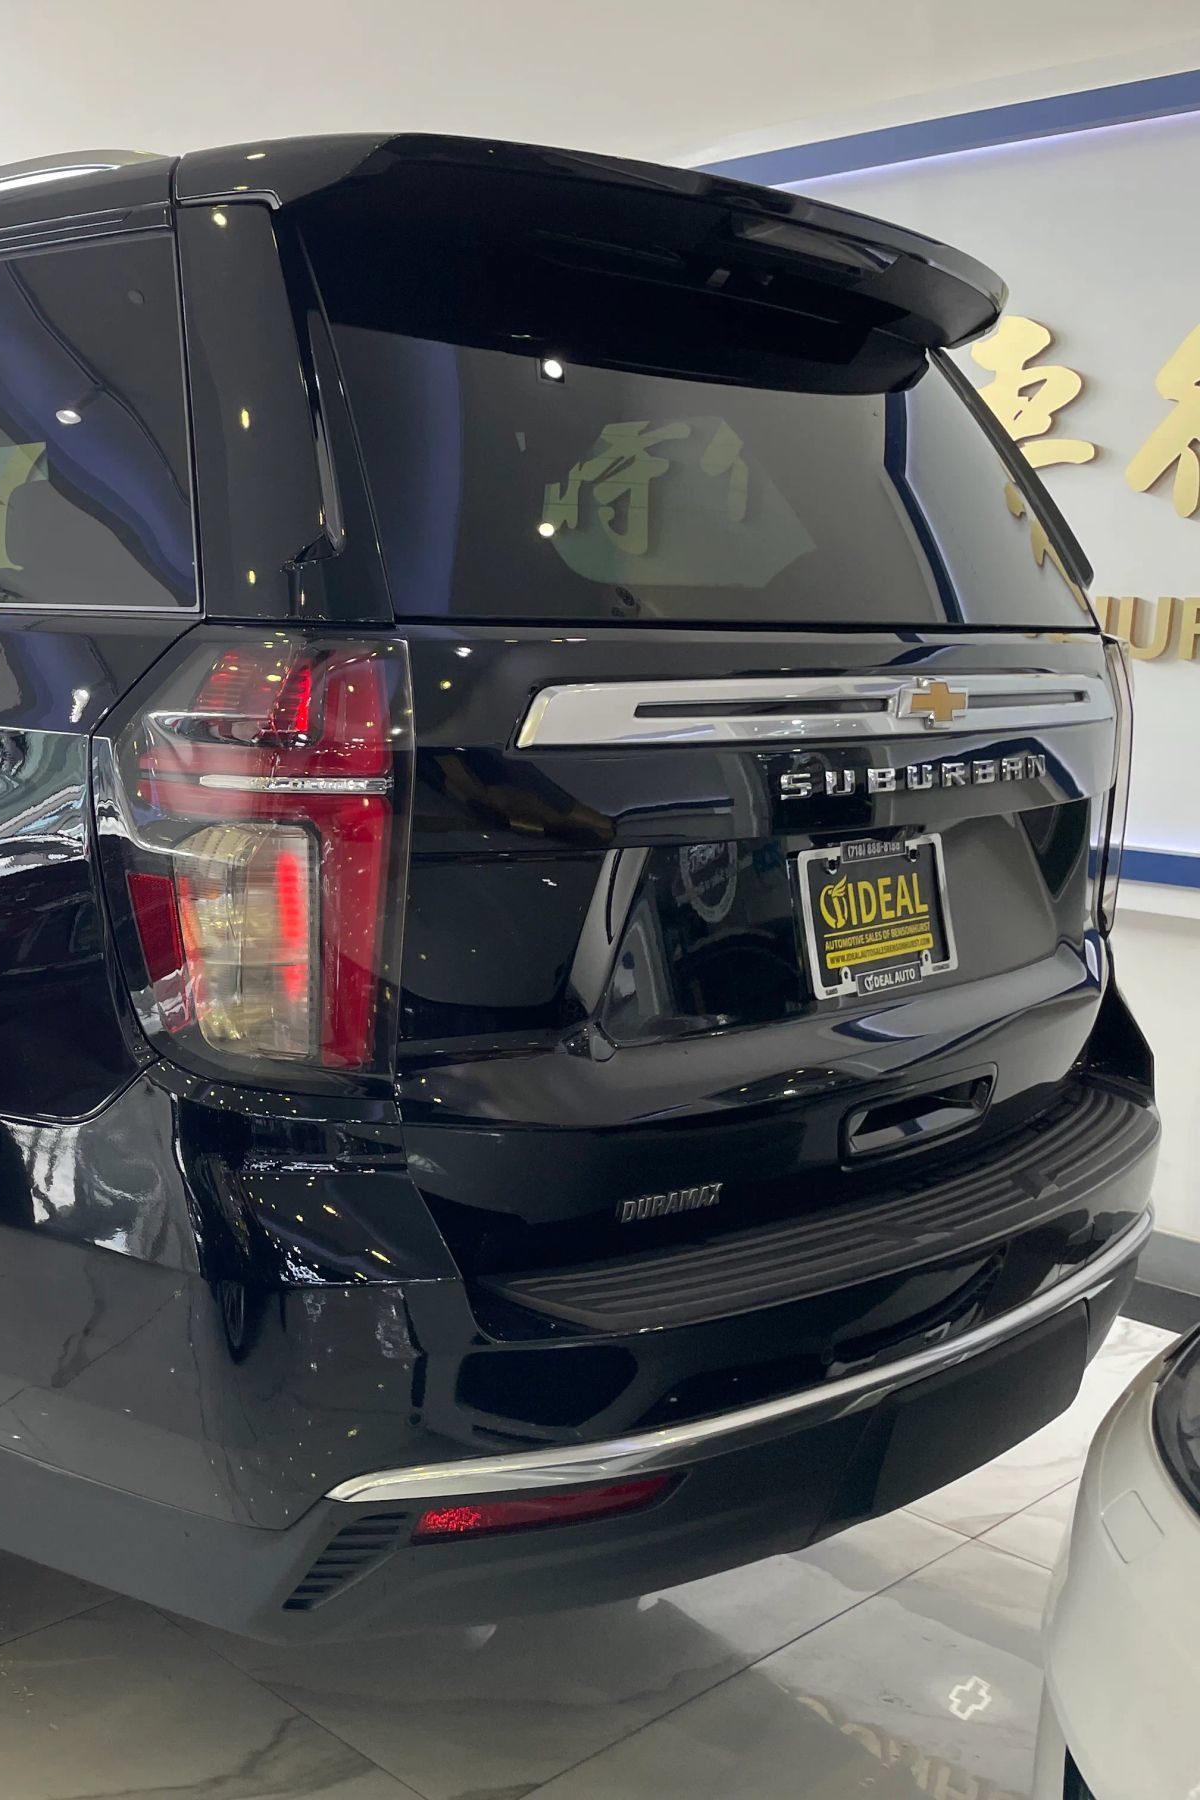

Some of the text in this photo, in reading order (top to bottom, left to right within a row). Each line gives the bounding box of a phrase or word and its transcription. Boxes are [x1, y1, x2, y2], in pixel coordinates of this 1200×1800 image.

[780, 754, 1047, 800] SUBURBAN
[847, 873, 928, 926] IDEAL
[825, 934, 865, 951] AUTOMOTIVE
[866, 931, 882, 943] SALES
[882, 929, 890, 940] OF
[895, 968, 915, 983] AUTO
[620, 1182, 724, 1224] DURAMAX
